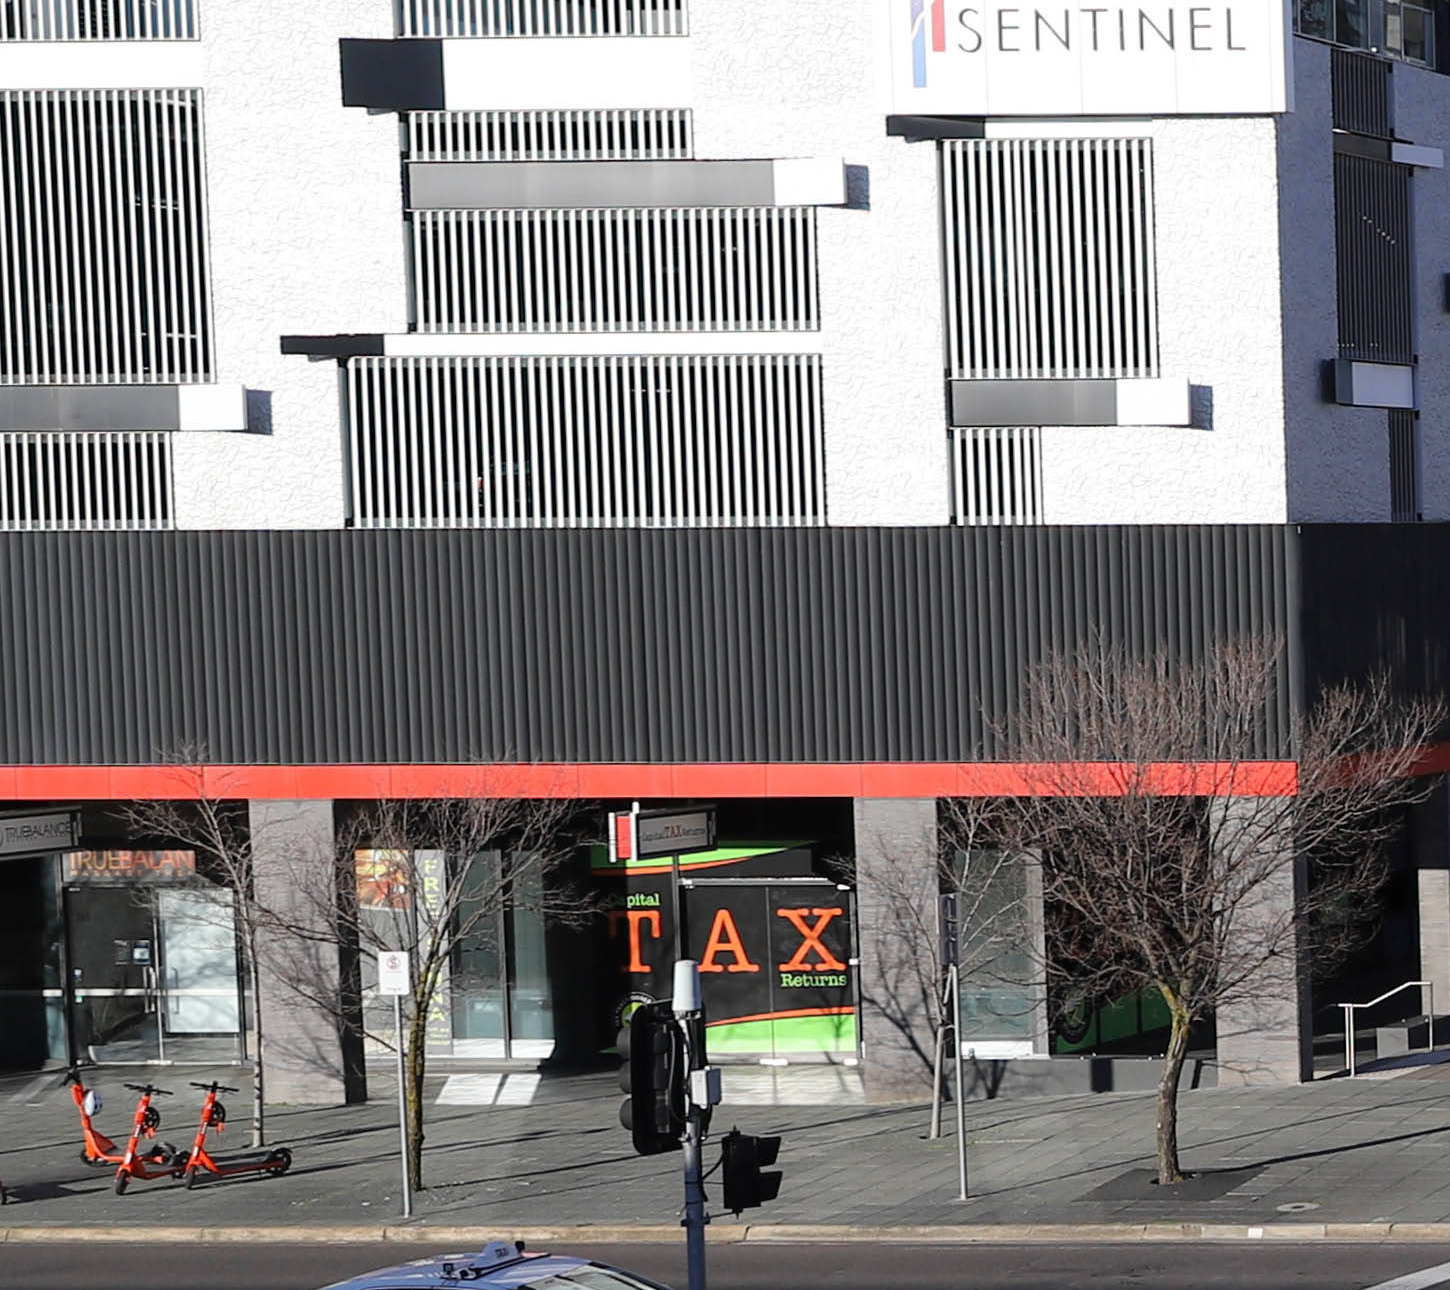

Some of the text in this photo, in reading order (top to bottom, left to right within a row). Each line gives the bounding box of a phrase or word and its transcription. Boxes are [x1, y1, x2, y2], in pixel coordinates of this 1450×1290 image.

[958, 7, 1247, 53] SENTINEL
[608, 908, 847, 973] TAX
[780, 973, 848, 988] Returns
